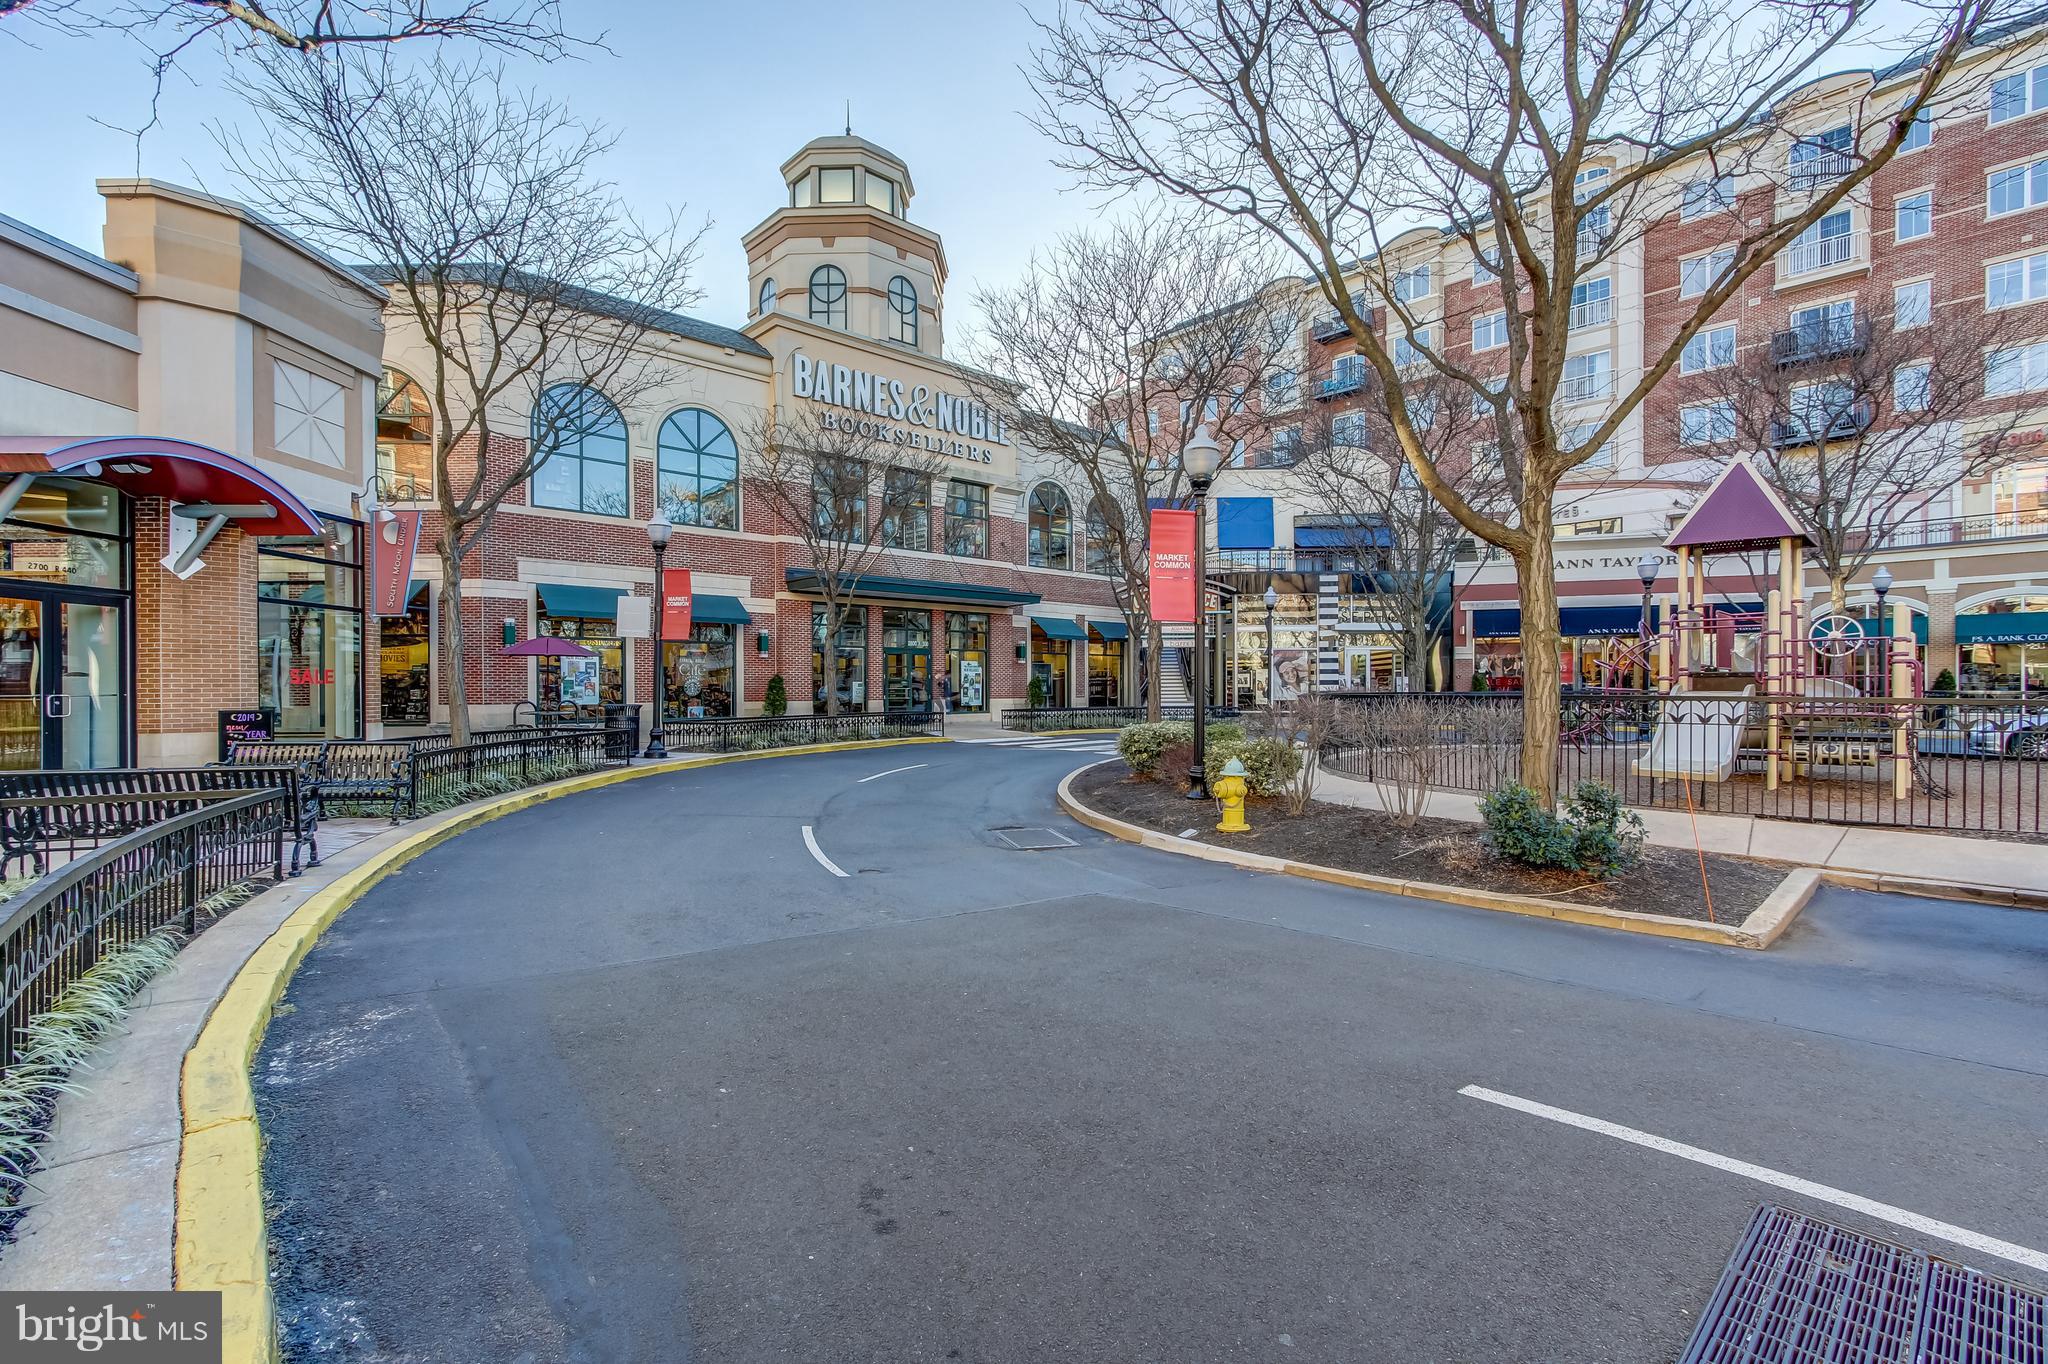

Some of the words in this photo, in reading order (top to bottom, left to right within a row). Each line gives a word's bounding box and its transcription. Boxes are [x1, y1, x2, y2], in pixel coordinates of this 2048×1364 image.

[793, 353, 904, 421] BARNES
[906, 384, 935, 428] &
[935, 391, 1009, 446] NOBLE
[822, 411, 993, 464] BOOKSELLERS
[397, 517, 408, 546] UNDER
[392, 549, 404, 576] MOON
[1156, 554, 1189, 562] MARKET
[1554, 559, 1593, 570] ANN
[27, 562, 49, 571] 2700
[1153, 561, 1191, 569] COMMON
[387, 578, 398, 608] SOUTH
[1341, 611, 1398, 621] SEPHO
[290, 669, 335, 685] SALE
[237, 713, 255, 721] 2019
